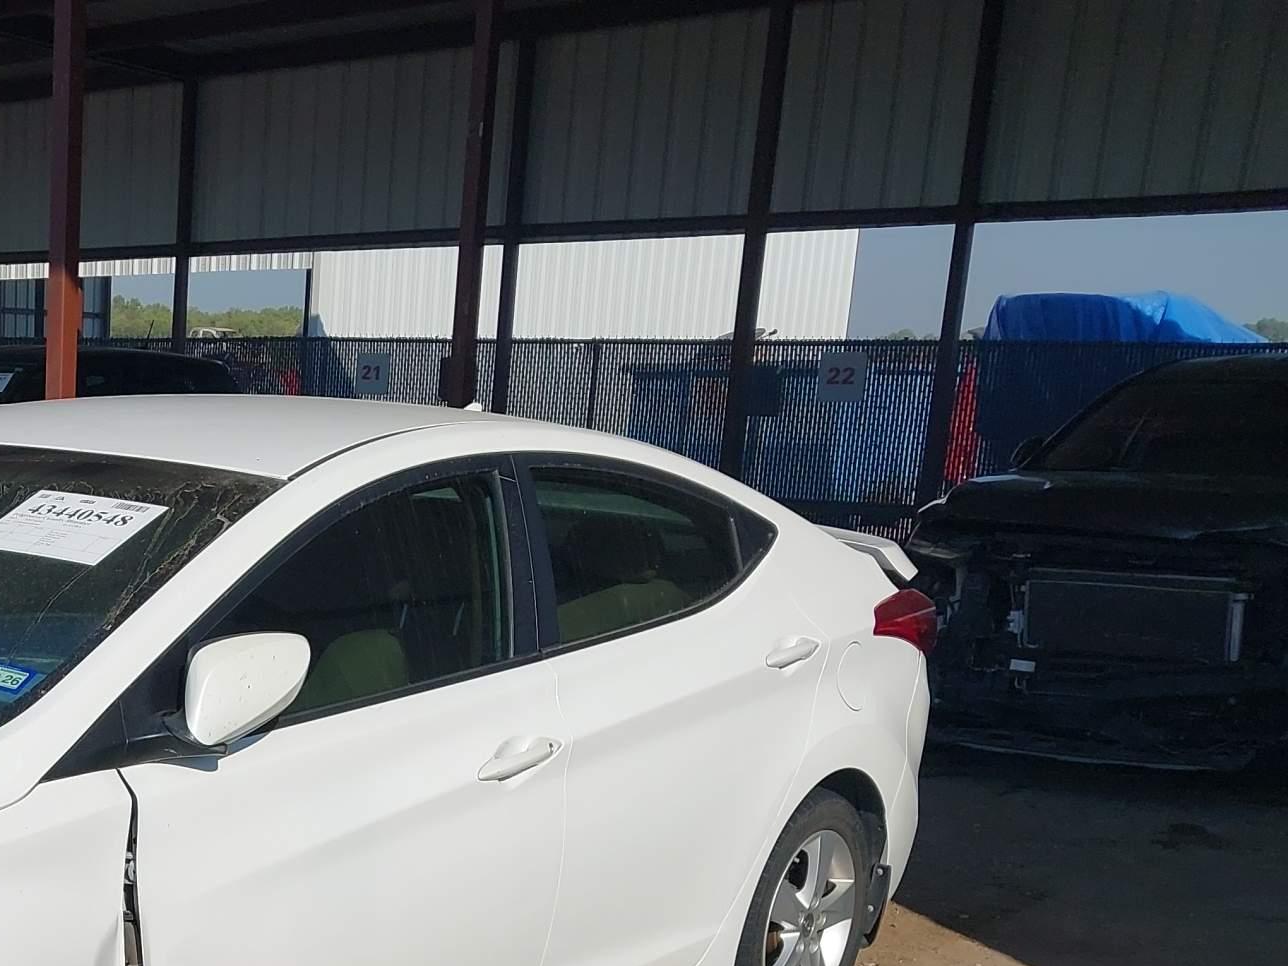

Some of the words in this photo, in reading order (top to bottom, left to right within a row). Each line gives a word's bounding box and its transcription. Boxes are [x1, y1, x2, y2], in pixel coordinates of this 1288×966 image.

[361, 365, 381, 380] 21
[826, 367, 855, 385] 22
[27, 503, 134, 528] 43440548
[1, 674, 23, 686] 26
